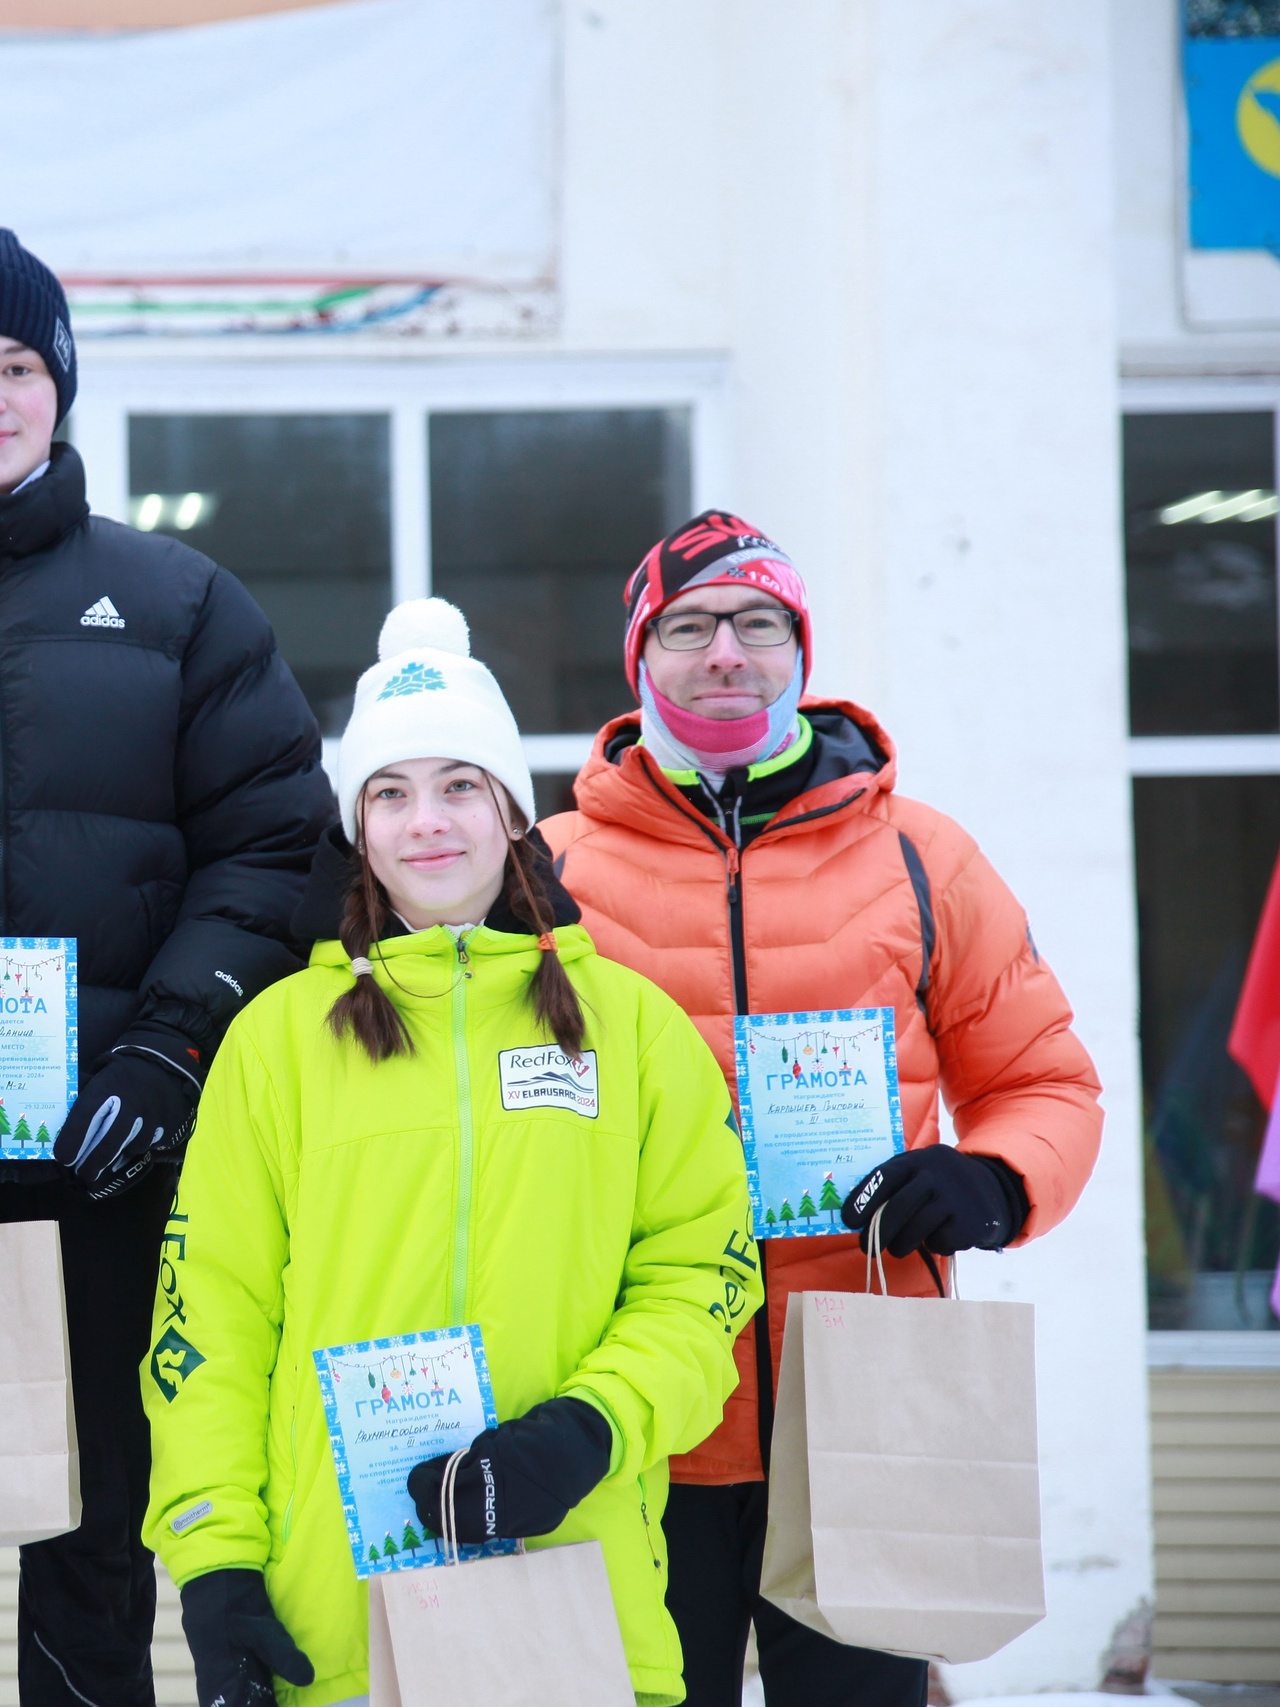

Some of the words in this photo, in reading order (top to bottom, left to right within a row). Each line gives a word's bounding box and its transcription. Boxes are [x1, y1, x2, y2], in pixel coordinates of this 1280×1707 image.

[80, 614, 126, 629] adidas
[214, 970, 244, 997] adidas
[510, 1051, 573, 1068] RedFox
[767, 1070, 867, 1090] ГРАМОТА
[576, 1096, 595, 1108] 2024
[355, 1388, 462, 1418] ГРАМОТА
[386, 1413, 439, 1425] Награждается
[420, 1439, 444, 1447] МЕСТО
[480, 1458, 496, 1535] NORDSKI
